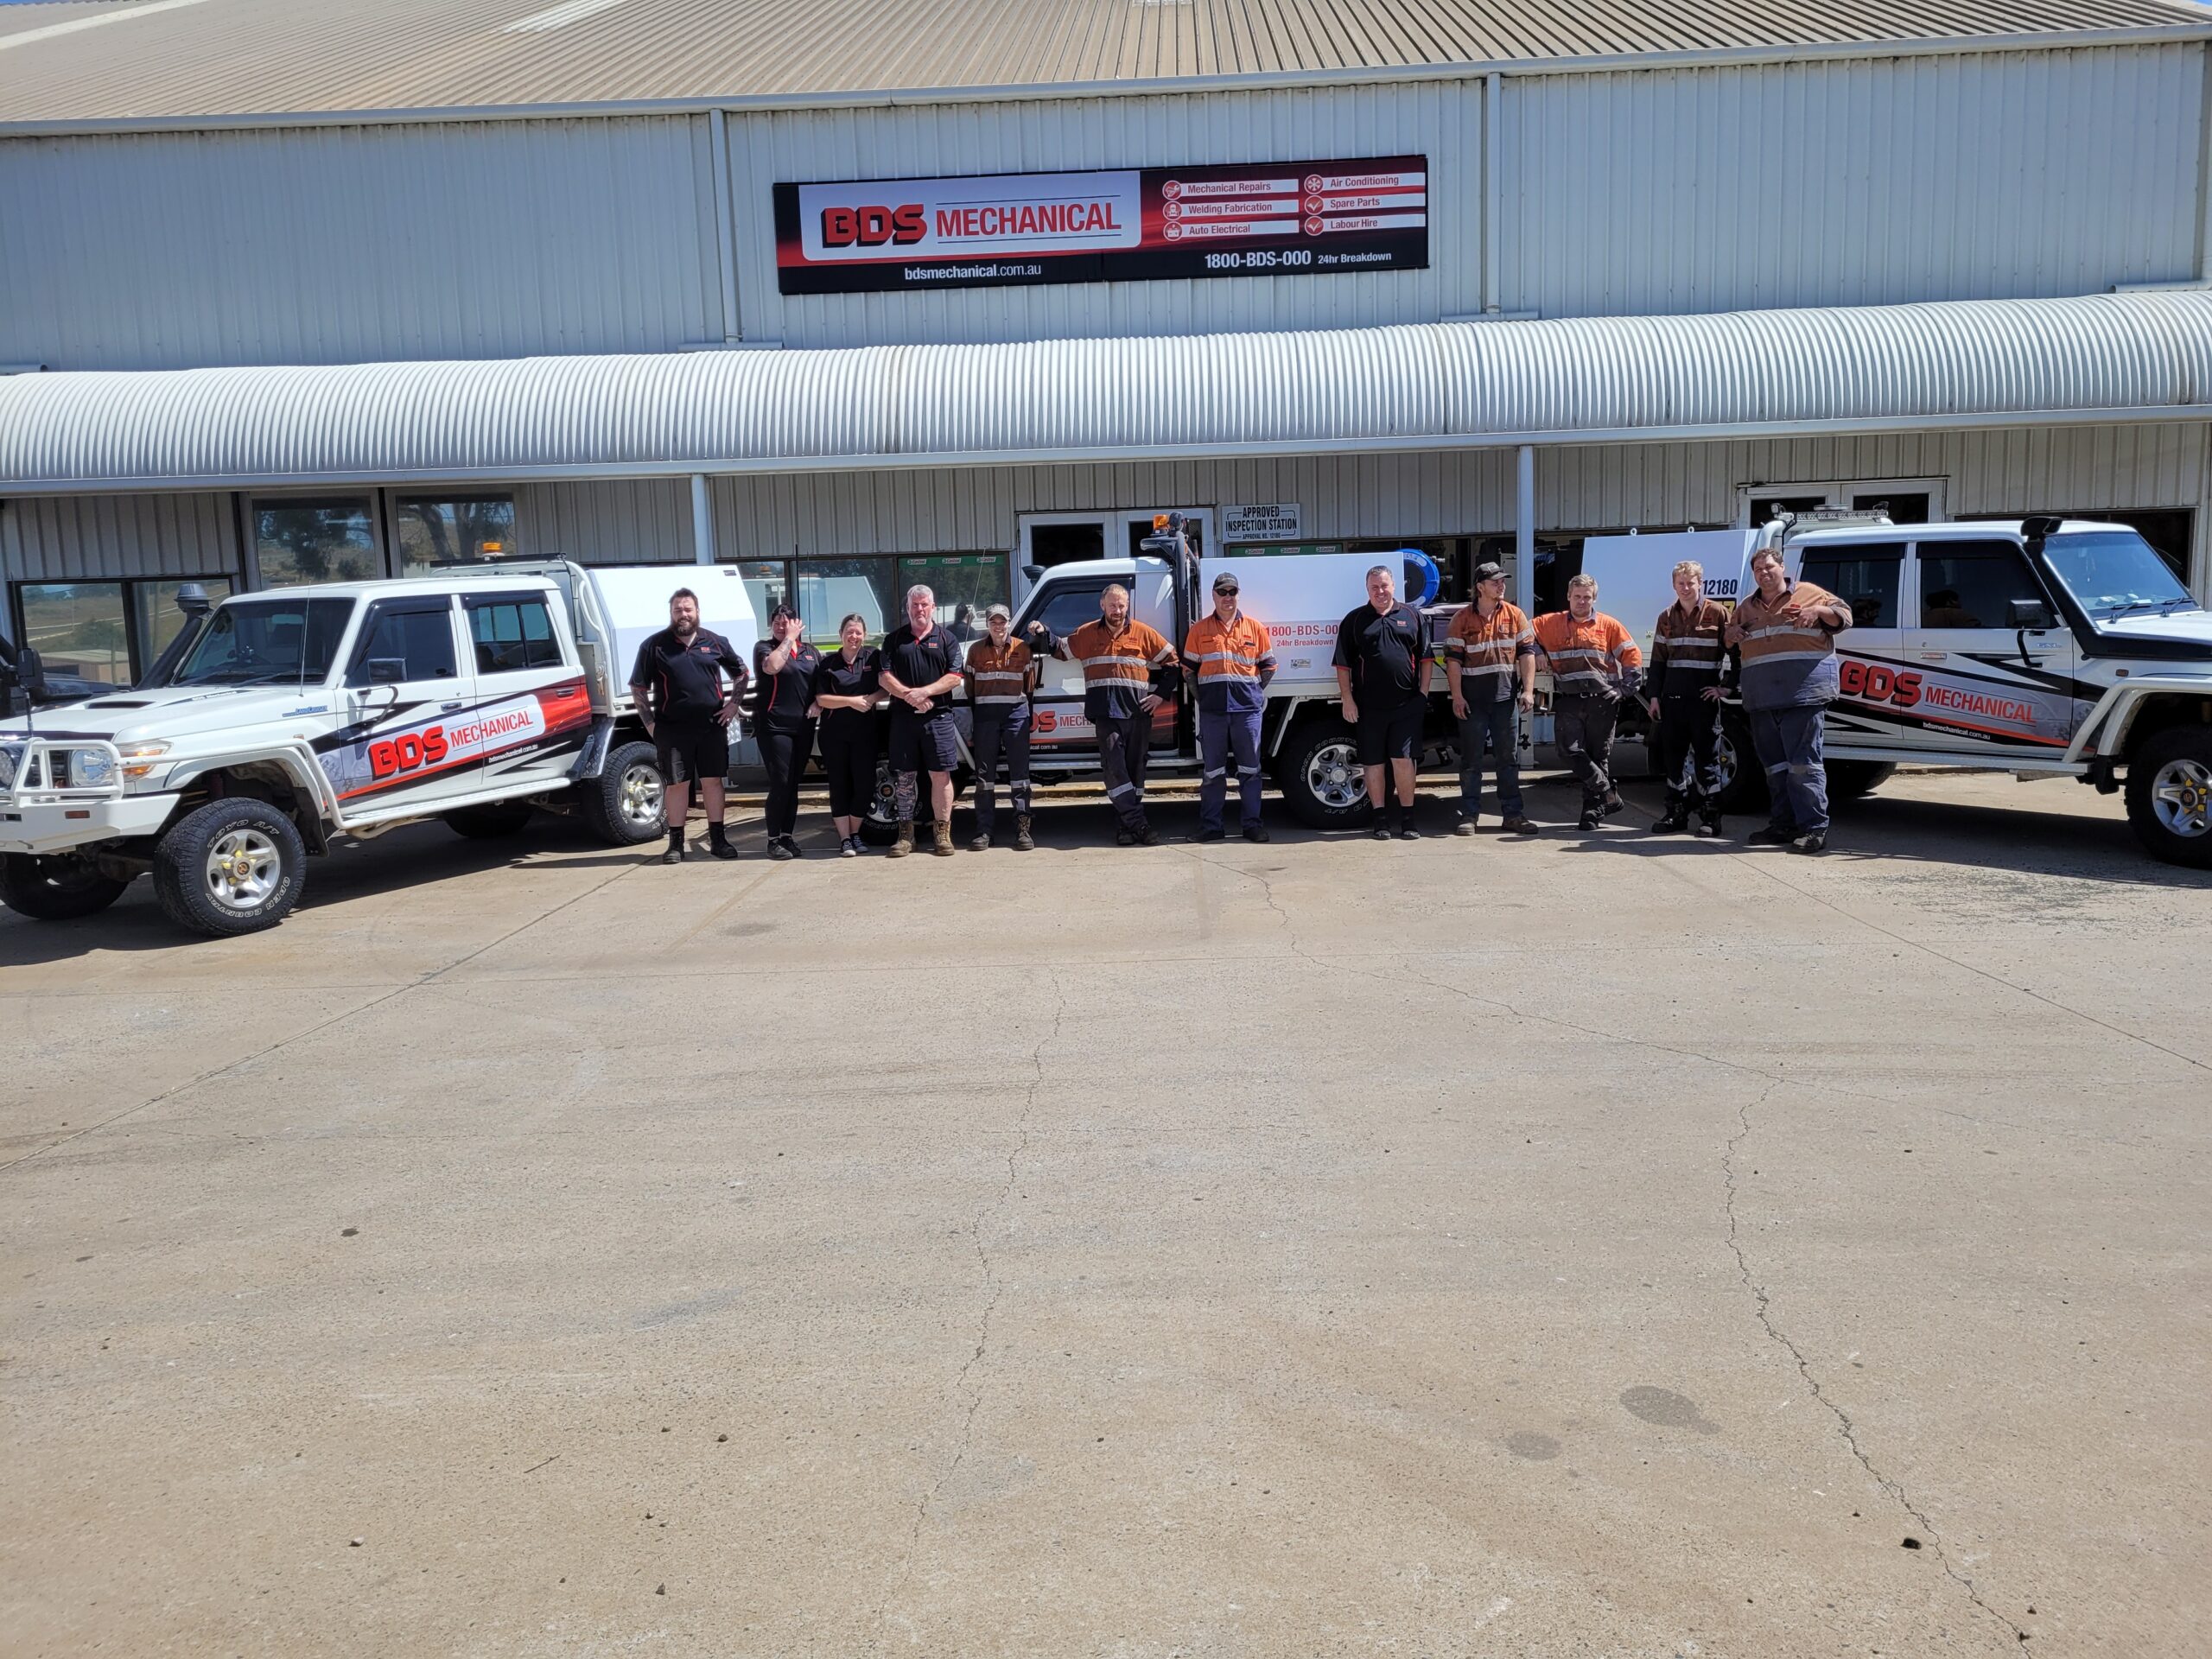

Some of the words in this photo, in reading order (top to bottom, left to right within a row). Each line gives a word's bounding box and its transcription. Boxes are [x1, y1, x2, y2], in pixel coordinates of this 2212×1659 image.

[1187, 182, 1236, 194] Mechanical
[1238, 181, 1271, 193] Repairs
[1330, 177, 1341, 188] Air
[1343, 175, 1399, 187] Conditioning
[1188, 204, 1222, 216] Welding
[1224, 202, 1272, 213] Fabrication
[1330, 199, 1356, 210] Spare
[1357, 197, 1380, 207] Parts
[821, 203, 928, 248] BDS
[936, 202, 1122, 238] MECHANICAL
[1189, 226, 1209, 235] Auto
[1211, 224, 1250, 234] Electrical
[1330, 219, 1360, 229] Labour
[1361, 218, 1378, 228] Hire
[1205, 250, 1312, 269] 1800-BDS-000
[1318, 254, 1339, 264] 24hr
[1340, 251, 1392, 264] Breakdown
[904, 264, 1041, 281] bdsmechanical.com.au
[1243, 505, 1280, 518] APPROVED
[1225, 519, 1267, 532] INSPECTION
[1268, 518, 1297, 531] STATION
[1702, 579, 1738, 595] 12180
[1265, 624, 1339, 637] 1800-BDS-00
[1840, 660, 1923, 709] BDS
[1925, 686, 2037, 724] MECHANICAL
[1923, 721, 1991, 741] bdsmechanical.com.au
[368, 725, 449, 781] BDS
[449, 710, 534, 748] MECHANICAL
[207, 819, 249, 849] TOYO
[253, 821, 281, 836] A/T
[265, 876, 290, 911] OPEN
[205, 893, 263, 918] COUNTRY
